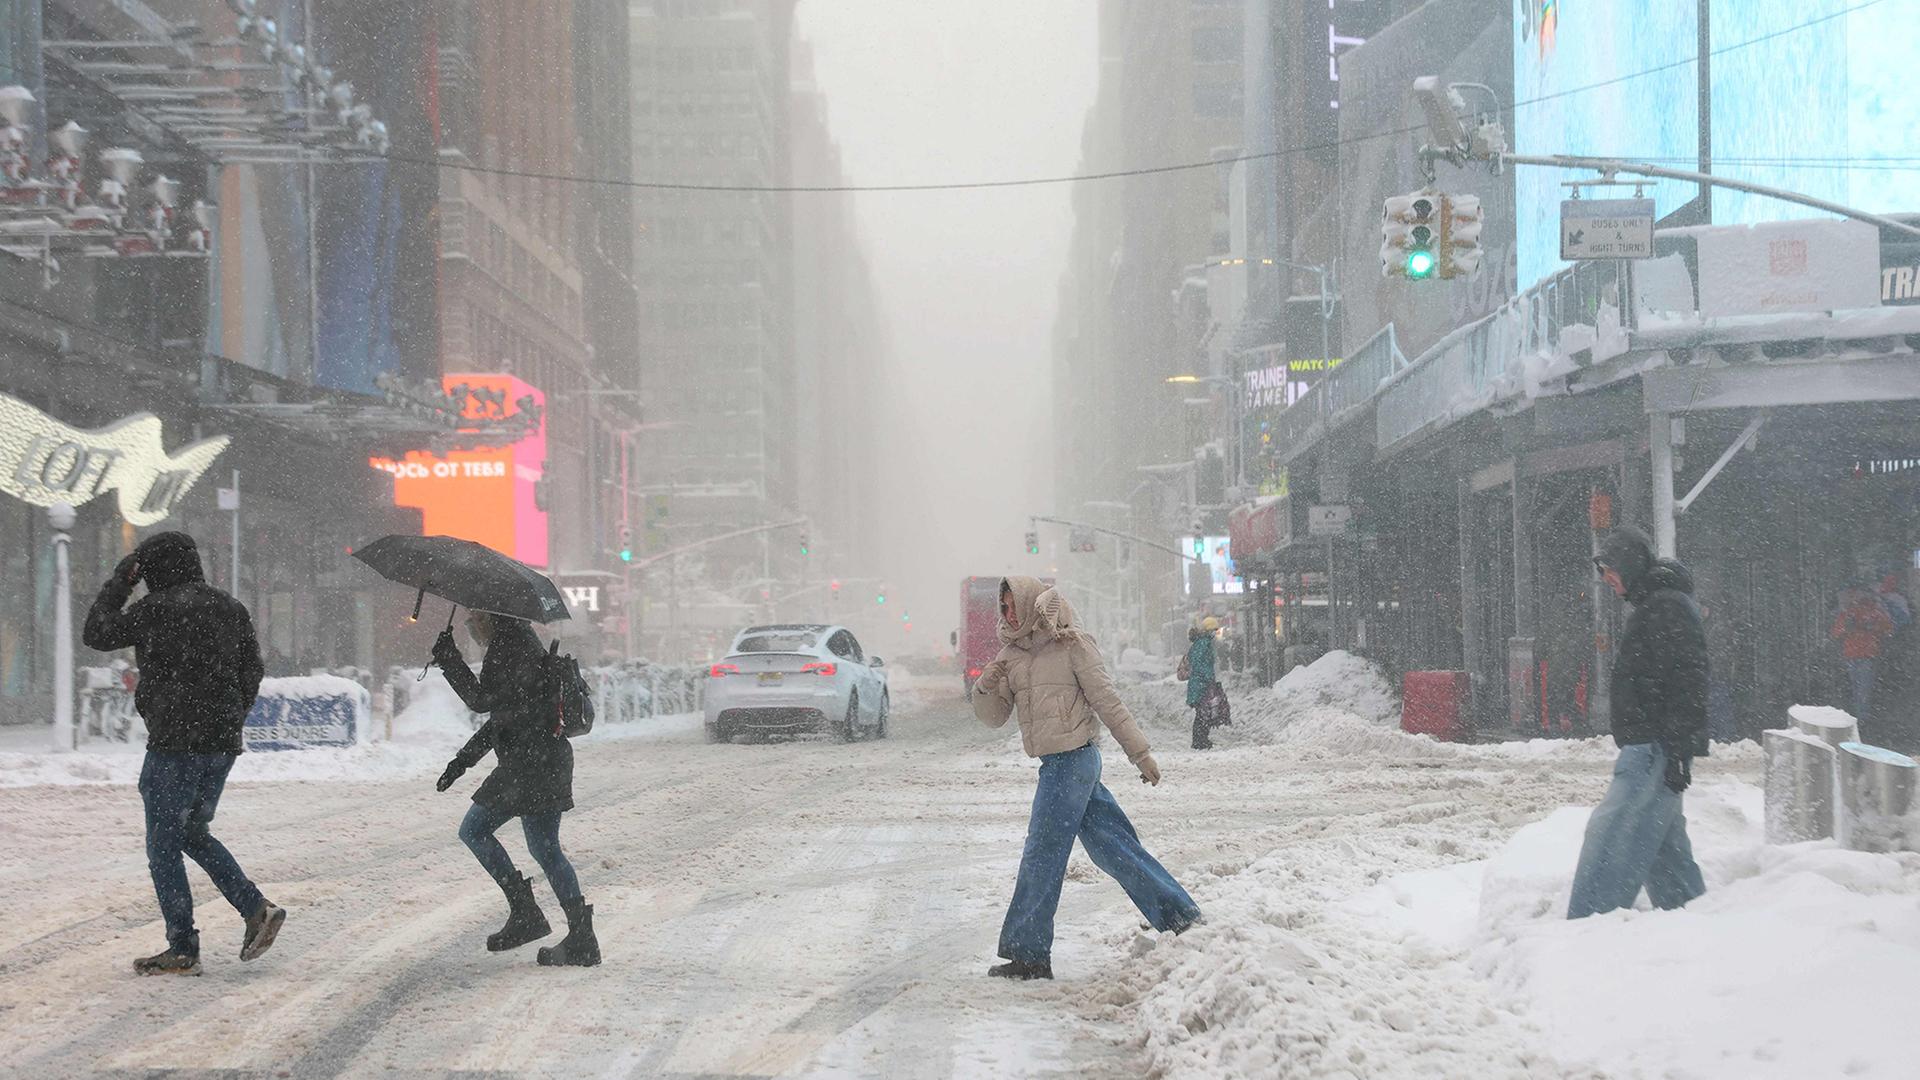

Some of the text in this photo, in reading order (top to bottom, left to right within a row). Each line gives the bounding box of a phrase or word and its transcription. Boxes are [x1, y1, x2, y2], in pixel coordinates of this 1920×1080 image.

[1591, 219, 1619, 229] BUSES
[1615, 231, 1623, 241] &
[1589, 242, 1646, 253] RIGHT TURNS
[433, 461, 459, 478] ОТ
[463, 460, 506, 477] ТЕБЯ
